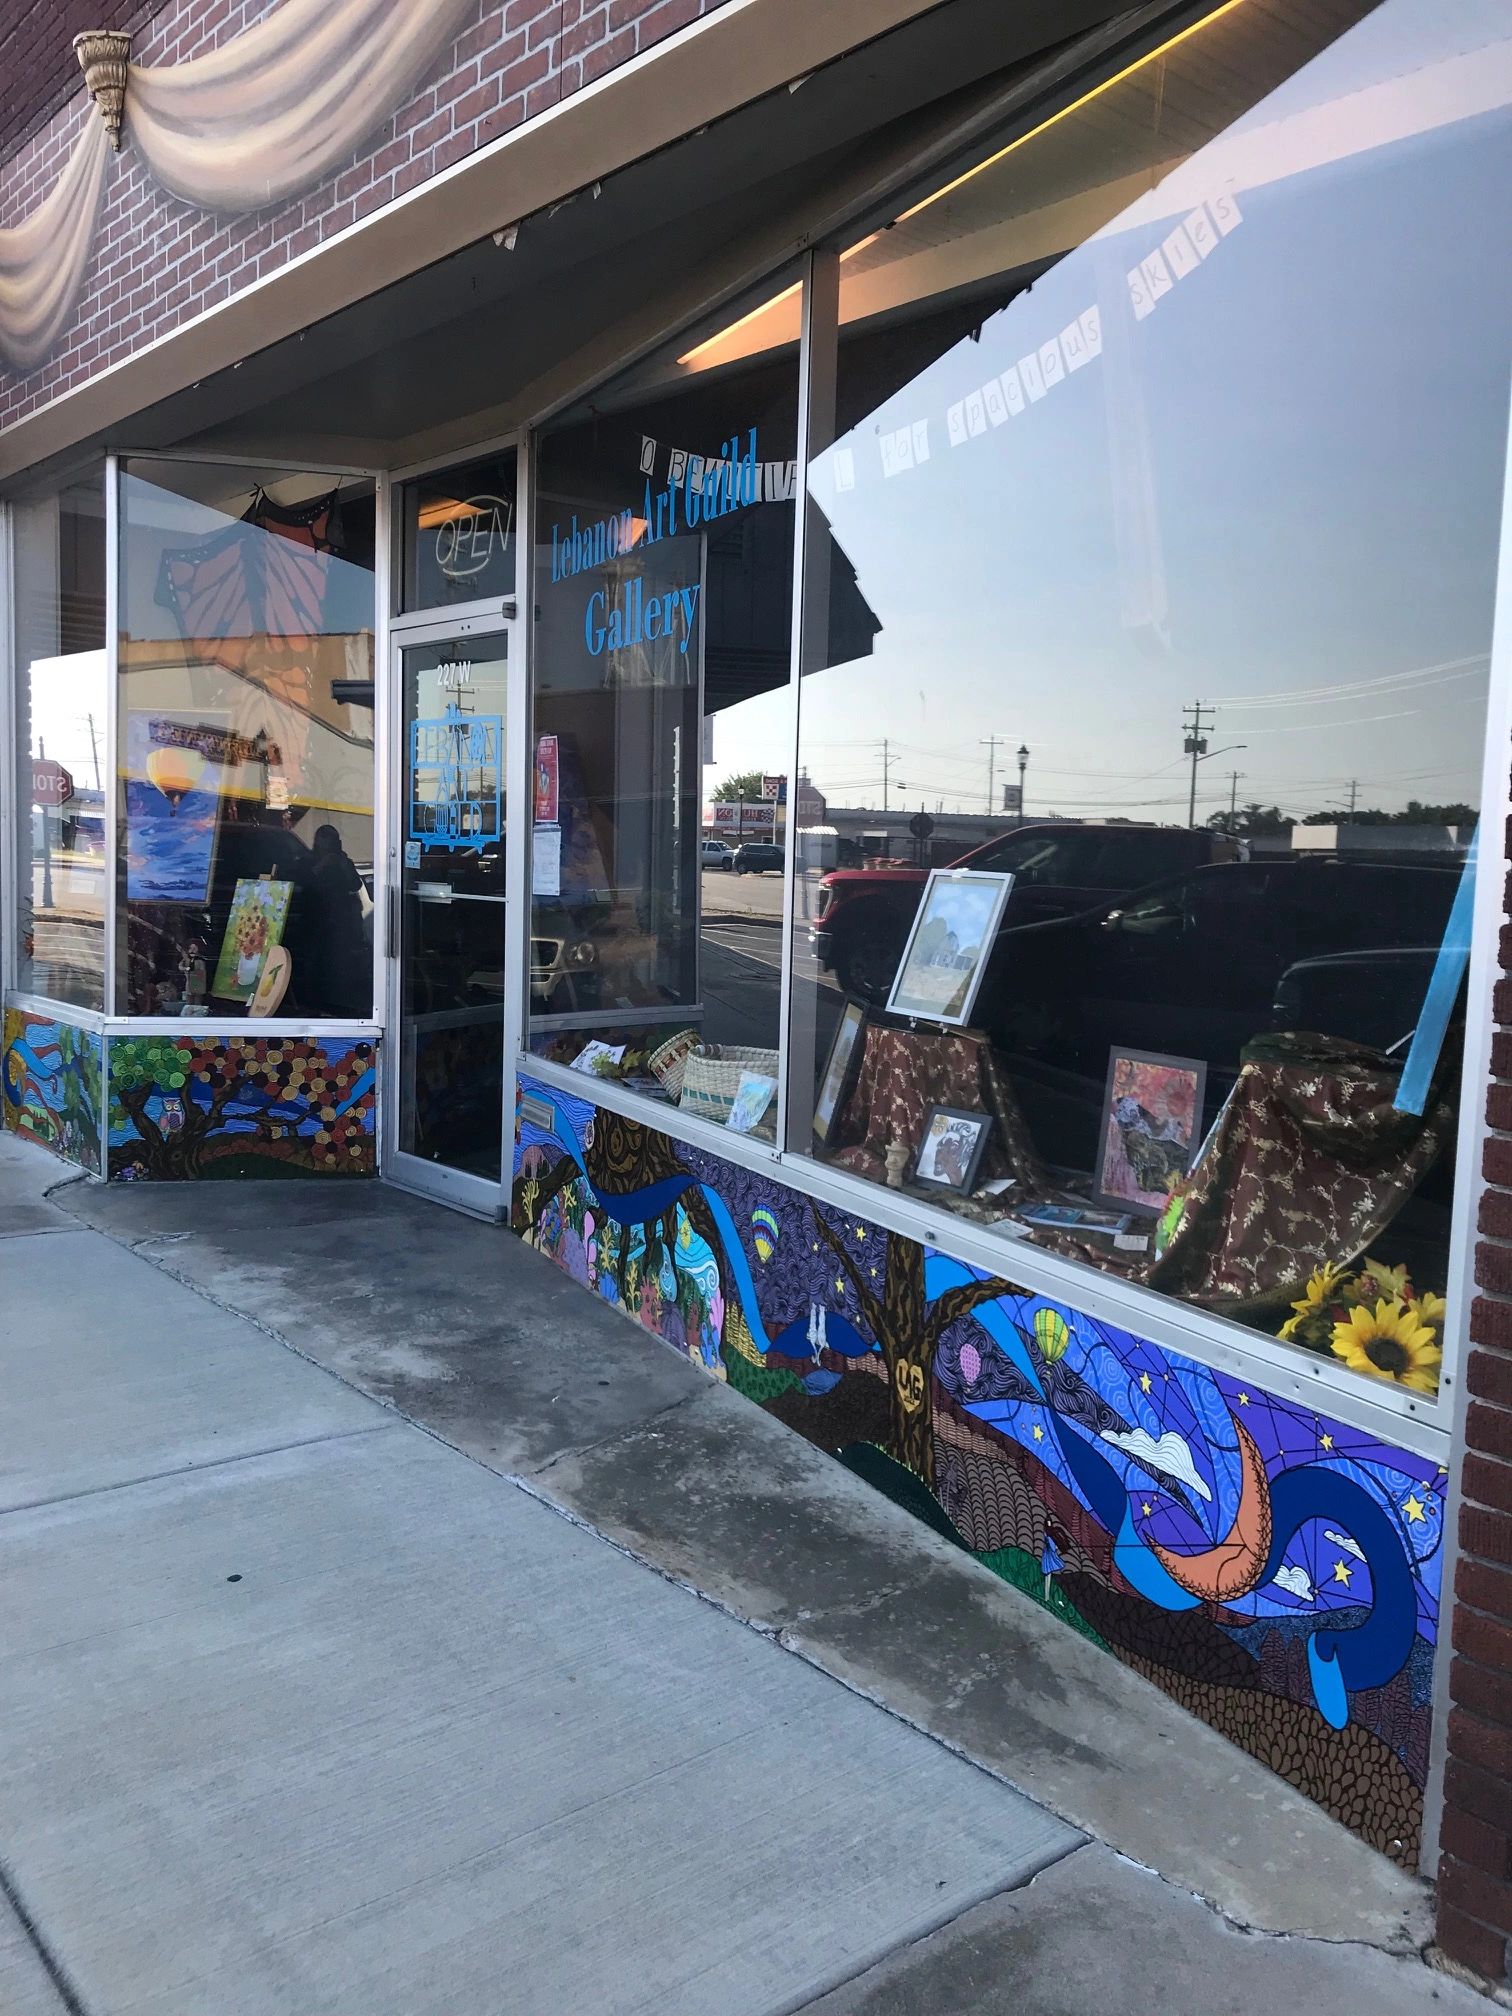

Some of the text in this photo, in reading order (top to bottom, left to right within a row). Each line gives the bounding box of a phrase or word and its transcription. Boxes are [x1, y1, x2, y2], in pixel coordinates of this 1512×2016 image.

[436, 503, 513, 564] OPEN
[552, 427, 757, 584] Lebanon Art Guild
[585, 577, 700, 656] Gallery
[437, 662, 456, 686] 227
